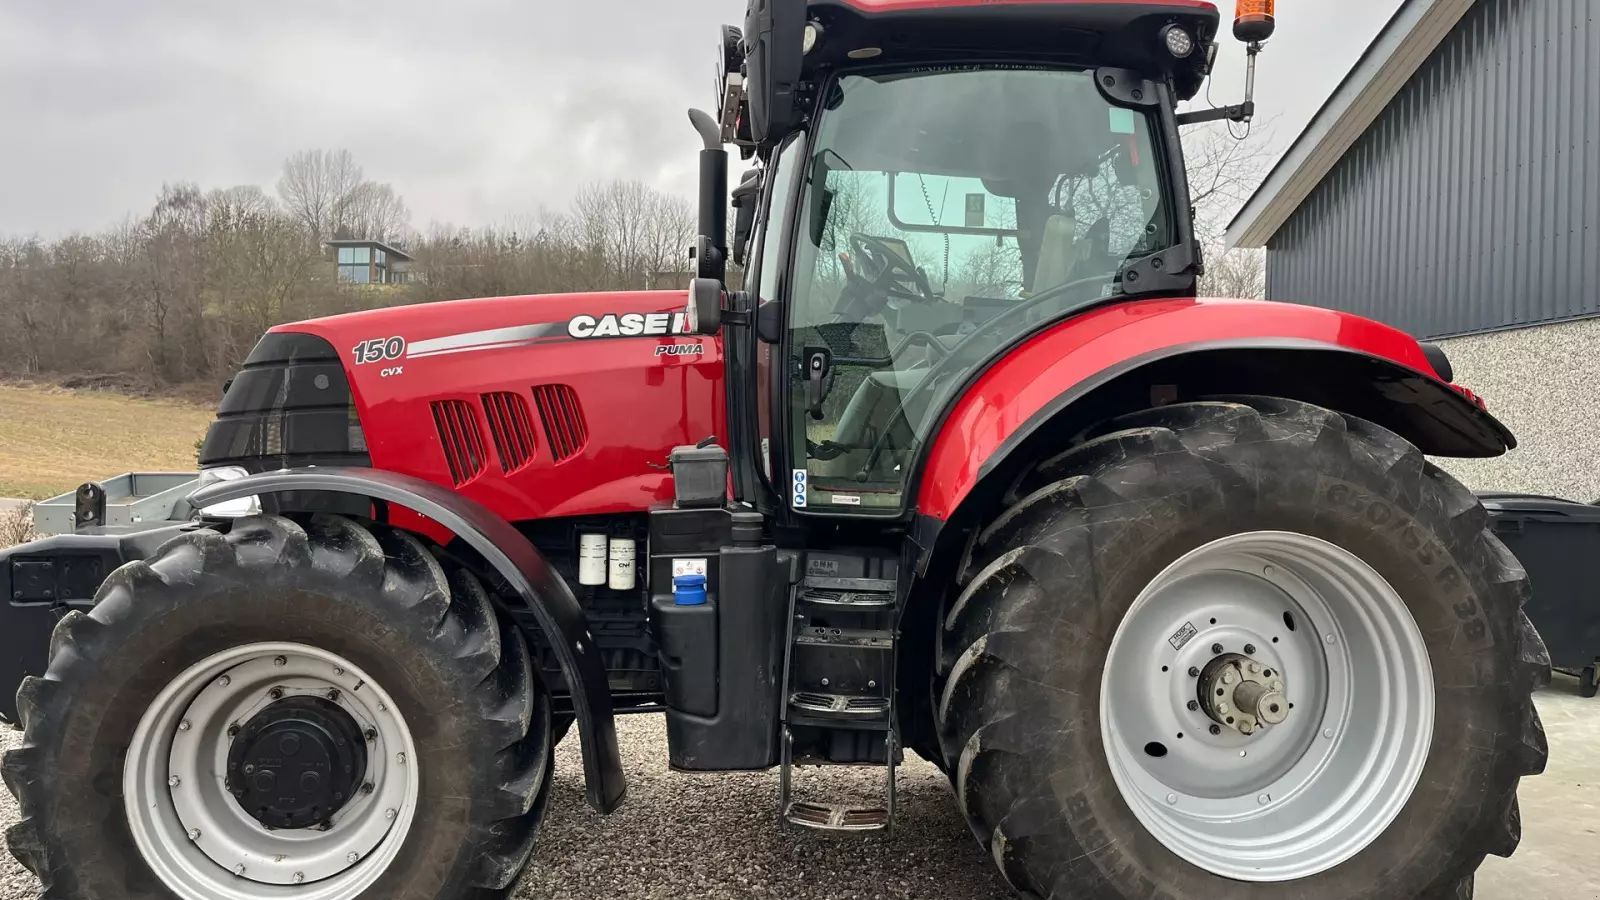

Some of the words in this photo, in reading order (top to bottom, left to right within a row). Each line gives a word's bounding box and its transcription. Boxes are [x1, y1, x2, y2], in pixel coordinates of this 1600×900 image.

[567, 312, 670, 338] CASE
[352, 335, 406, 365] 150
[654, 343, 705, 356] PUMA
[380, 366, 404, 377] CVX
